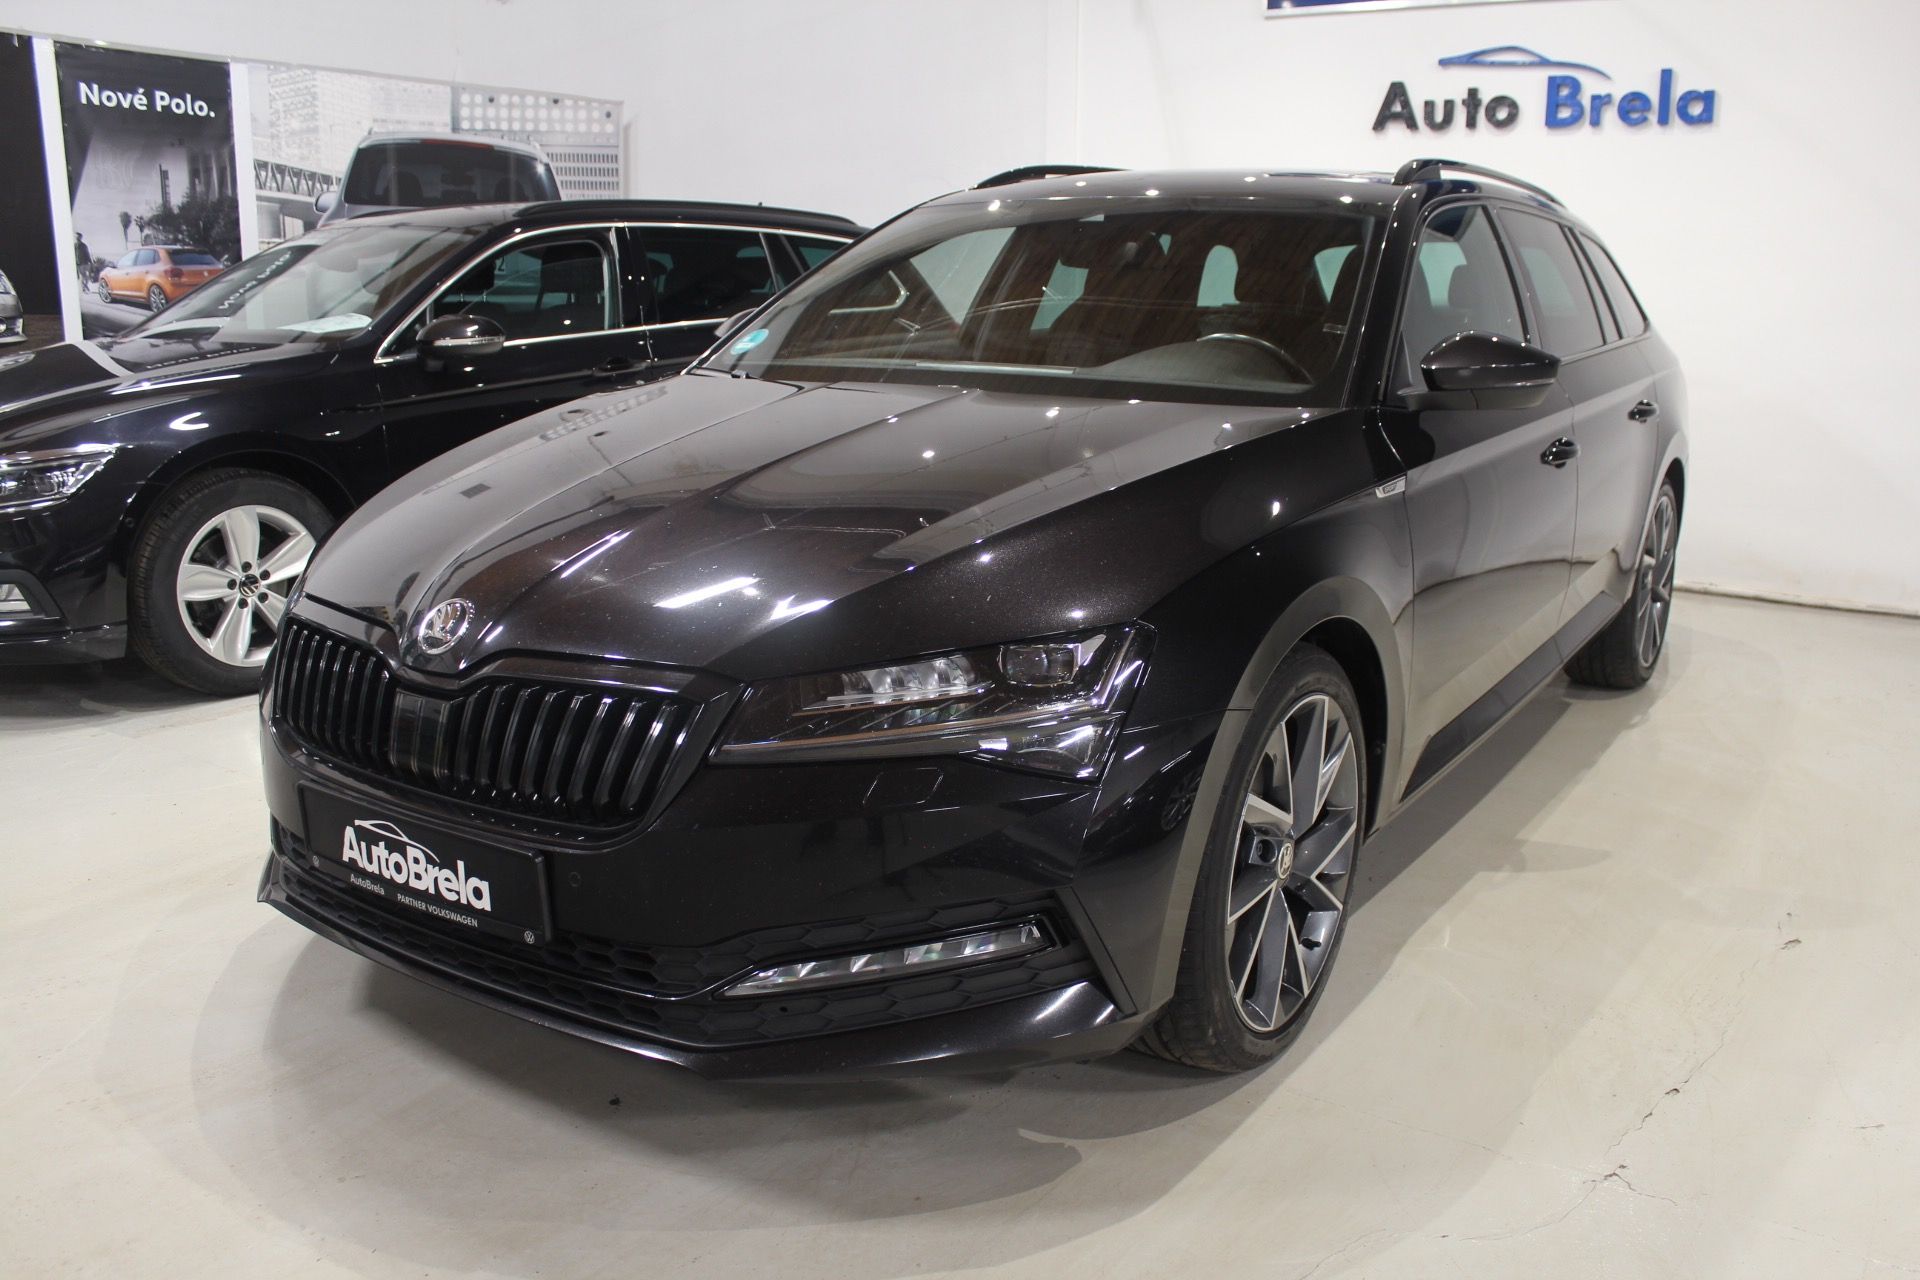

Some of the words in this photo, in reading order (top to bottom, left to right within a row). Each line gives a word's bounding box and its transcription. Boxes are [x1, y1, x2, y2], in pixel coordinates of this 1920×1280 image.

[79, 81, 148, 111] Nové
[154, 90, 216, 118] Polo.
[1372, 81, 1520, 131] Auto
[1545, 68, 1716, 128] Brela
[342, 825, 491, 911] AutoBrela
[350, 873, 385, 895] AutoBrela
[397, 893, 426, 911] PARTNER
[427, 905, 478, 928] VOLKSWAGEN
